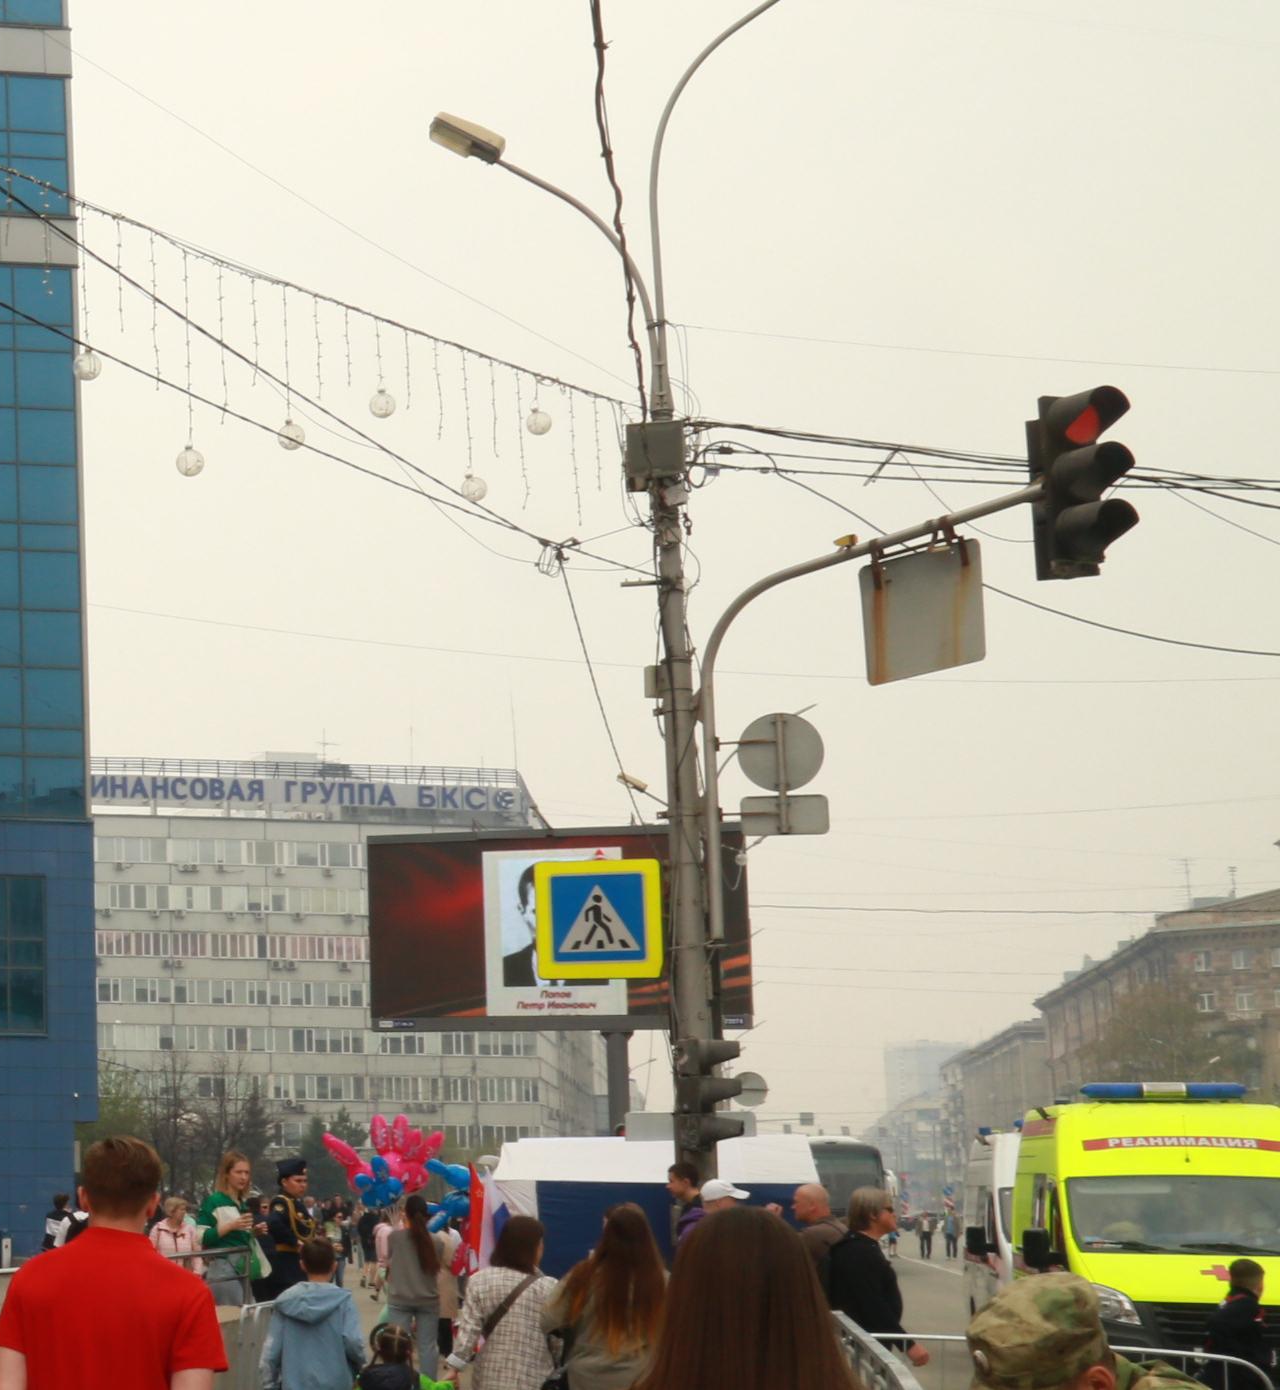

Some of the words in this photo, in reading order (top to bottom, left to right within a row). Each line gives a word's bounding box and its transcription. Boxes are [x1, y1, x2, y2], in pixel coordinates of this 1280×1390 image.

[91, 775, 265, 801] ИНАНСОВАЯ
[284, 780, 396, 807] ГРУППА
[417, 785, 486, 810] БКС
[1108, 1136, 1257, 1149] РЕАНИМАЦИЯ
